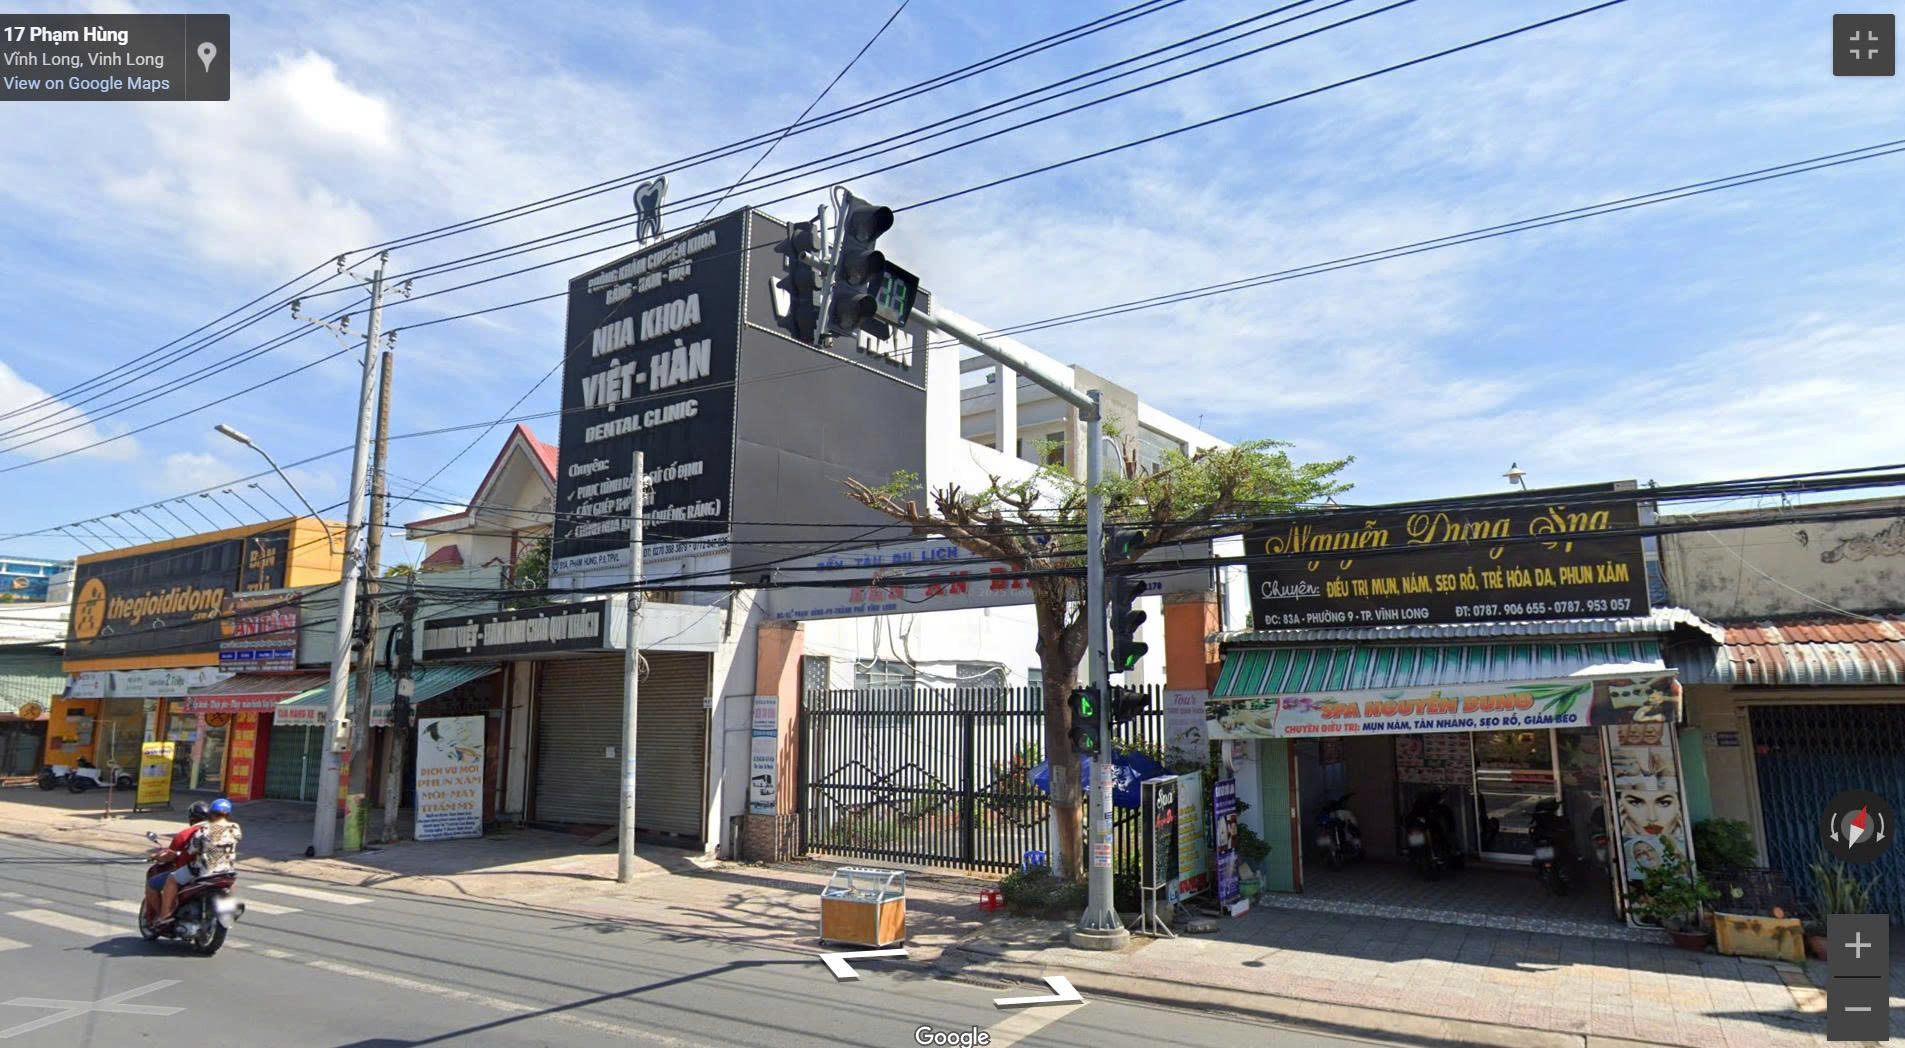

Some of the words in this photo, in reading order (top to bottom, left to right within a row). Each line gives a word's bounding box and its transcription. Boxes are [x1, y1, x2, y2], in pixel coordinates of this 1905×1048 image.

[592, 317, 635, 357] NHA
[640, 293, 701, 342] KHOA
[586, 414, 642, 443] DENTAL
[644, 399, 698, 427] CLINIC
[1261, 581, 1320, 600] Chuyên:
[1352, 579, 1368, 600] TRỊ
[1507, 565, 1532, 588] HÓA
[1535, 568, 1556, 588] DA,
[1559, 565, 1593, 585] PHUN
[1596, 560, 1630, 583] XĂM
[107, 585, 224, 623] thegioididong
[1283, 614, 1300, 624] 83A
[1306, 609, 1345, 624] PHƯỜNG
[1347, 611, 1353, 622] 9
[1360, 611, 1373, 622] TP.
[1375, 607, 1399, 621] VĨNH
[1401, 607, 1429, 619] LONG
[1455, 605, 1471, 617] ĐT:
[1504, 603, 1523, 615] 906
[1526, 602, 1545, 614] 655
[1587, 600, 1608, 611] 953
[1610, 598, 1631, 611] 057
[1284, 722, 1316, 734] CHUYÊN
[1363, 721, 1384, 734] MỤN
[1436, 717, 1477, 729] NHANG,
[1479, 716, 1500, 730] SẸO
[1321, 703, 1361, 719] SPA
